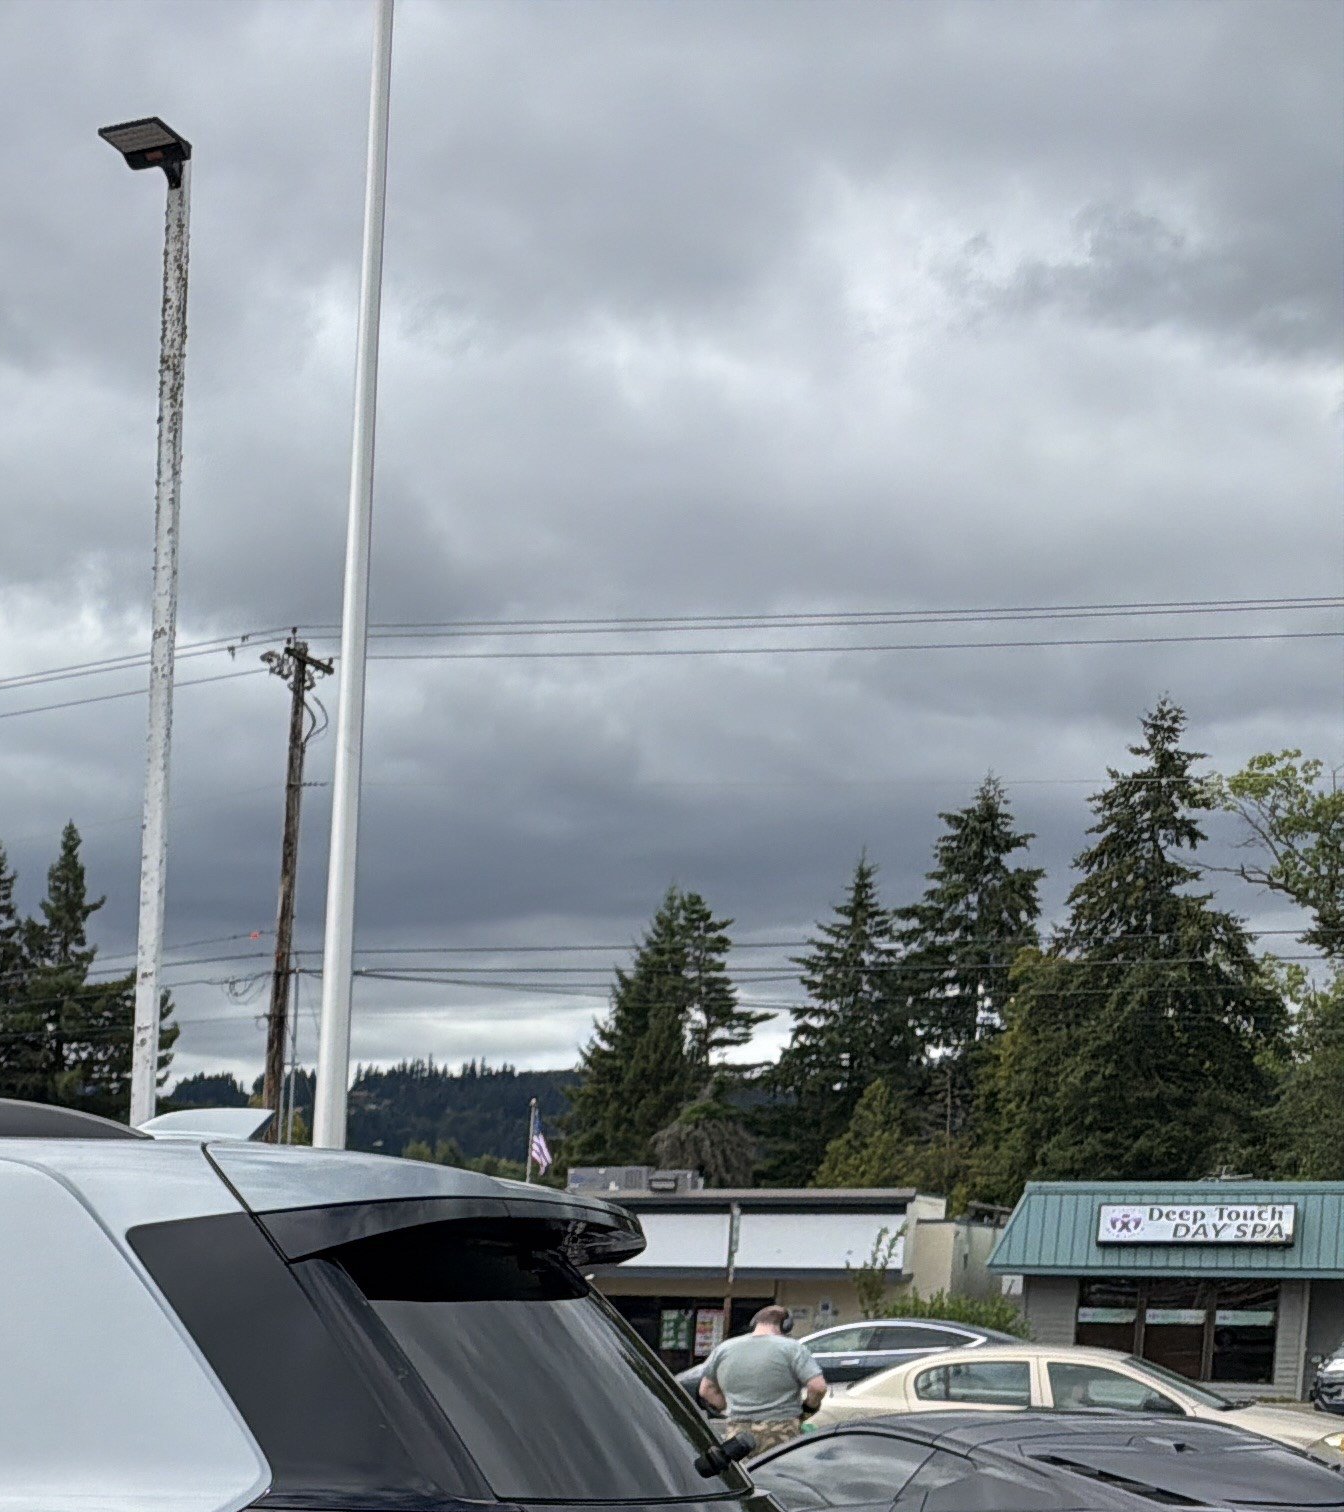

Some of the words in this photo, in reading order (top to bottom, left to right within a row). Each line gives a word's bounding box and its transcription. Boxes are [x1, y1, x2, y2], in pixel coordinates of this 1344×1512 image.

[1148, 1207, 1206, 1225] Deep
[1215, 1206, 1284, 1222] Touch
[1172, 1222, 1228, 1239] DAY
[1233, 1222, 1286, 1239] SPA
